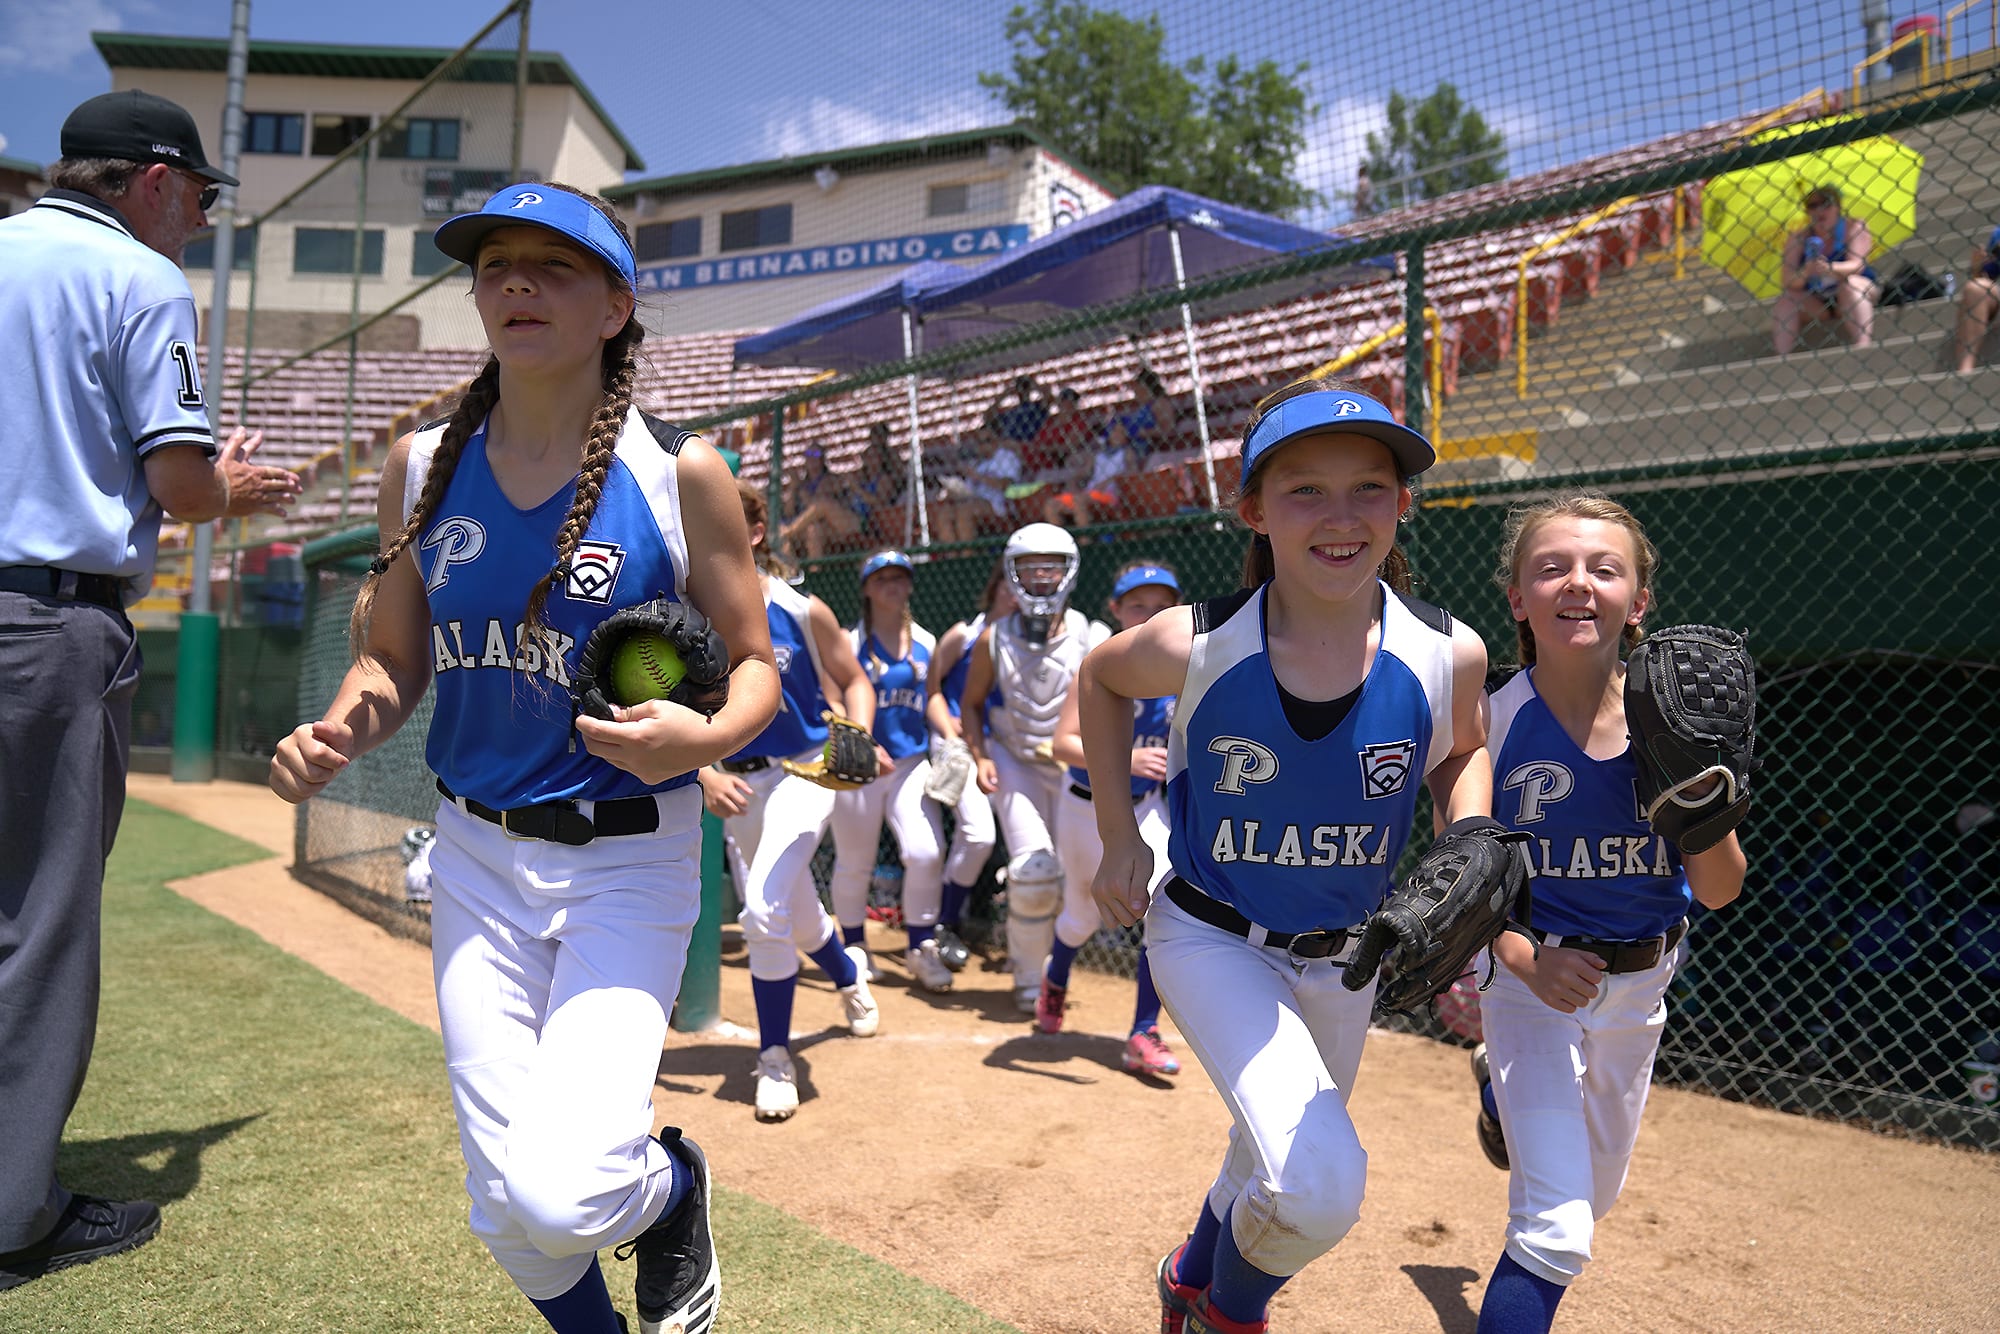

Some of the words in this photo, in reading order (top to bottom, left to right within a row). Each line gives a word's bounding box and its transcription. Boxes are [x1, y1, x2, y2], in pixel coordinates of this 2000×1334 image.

[509, 191, 544, 209] P
[642, 268, 682, 288] AN
[171, 341, 203, 406] 1
[1331, 398, 1363, 417] P
[421, 515, 487, 597] P
[431, 618, 576, 689] ALASK
[1207, 735, 1280, 796] P
[1503, 760, 1575, 825] P
[1211, 817, 1390, 868] ALASKA
